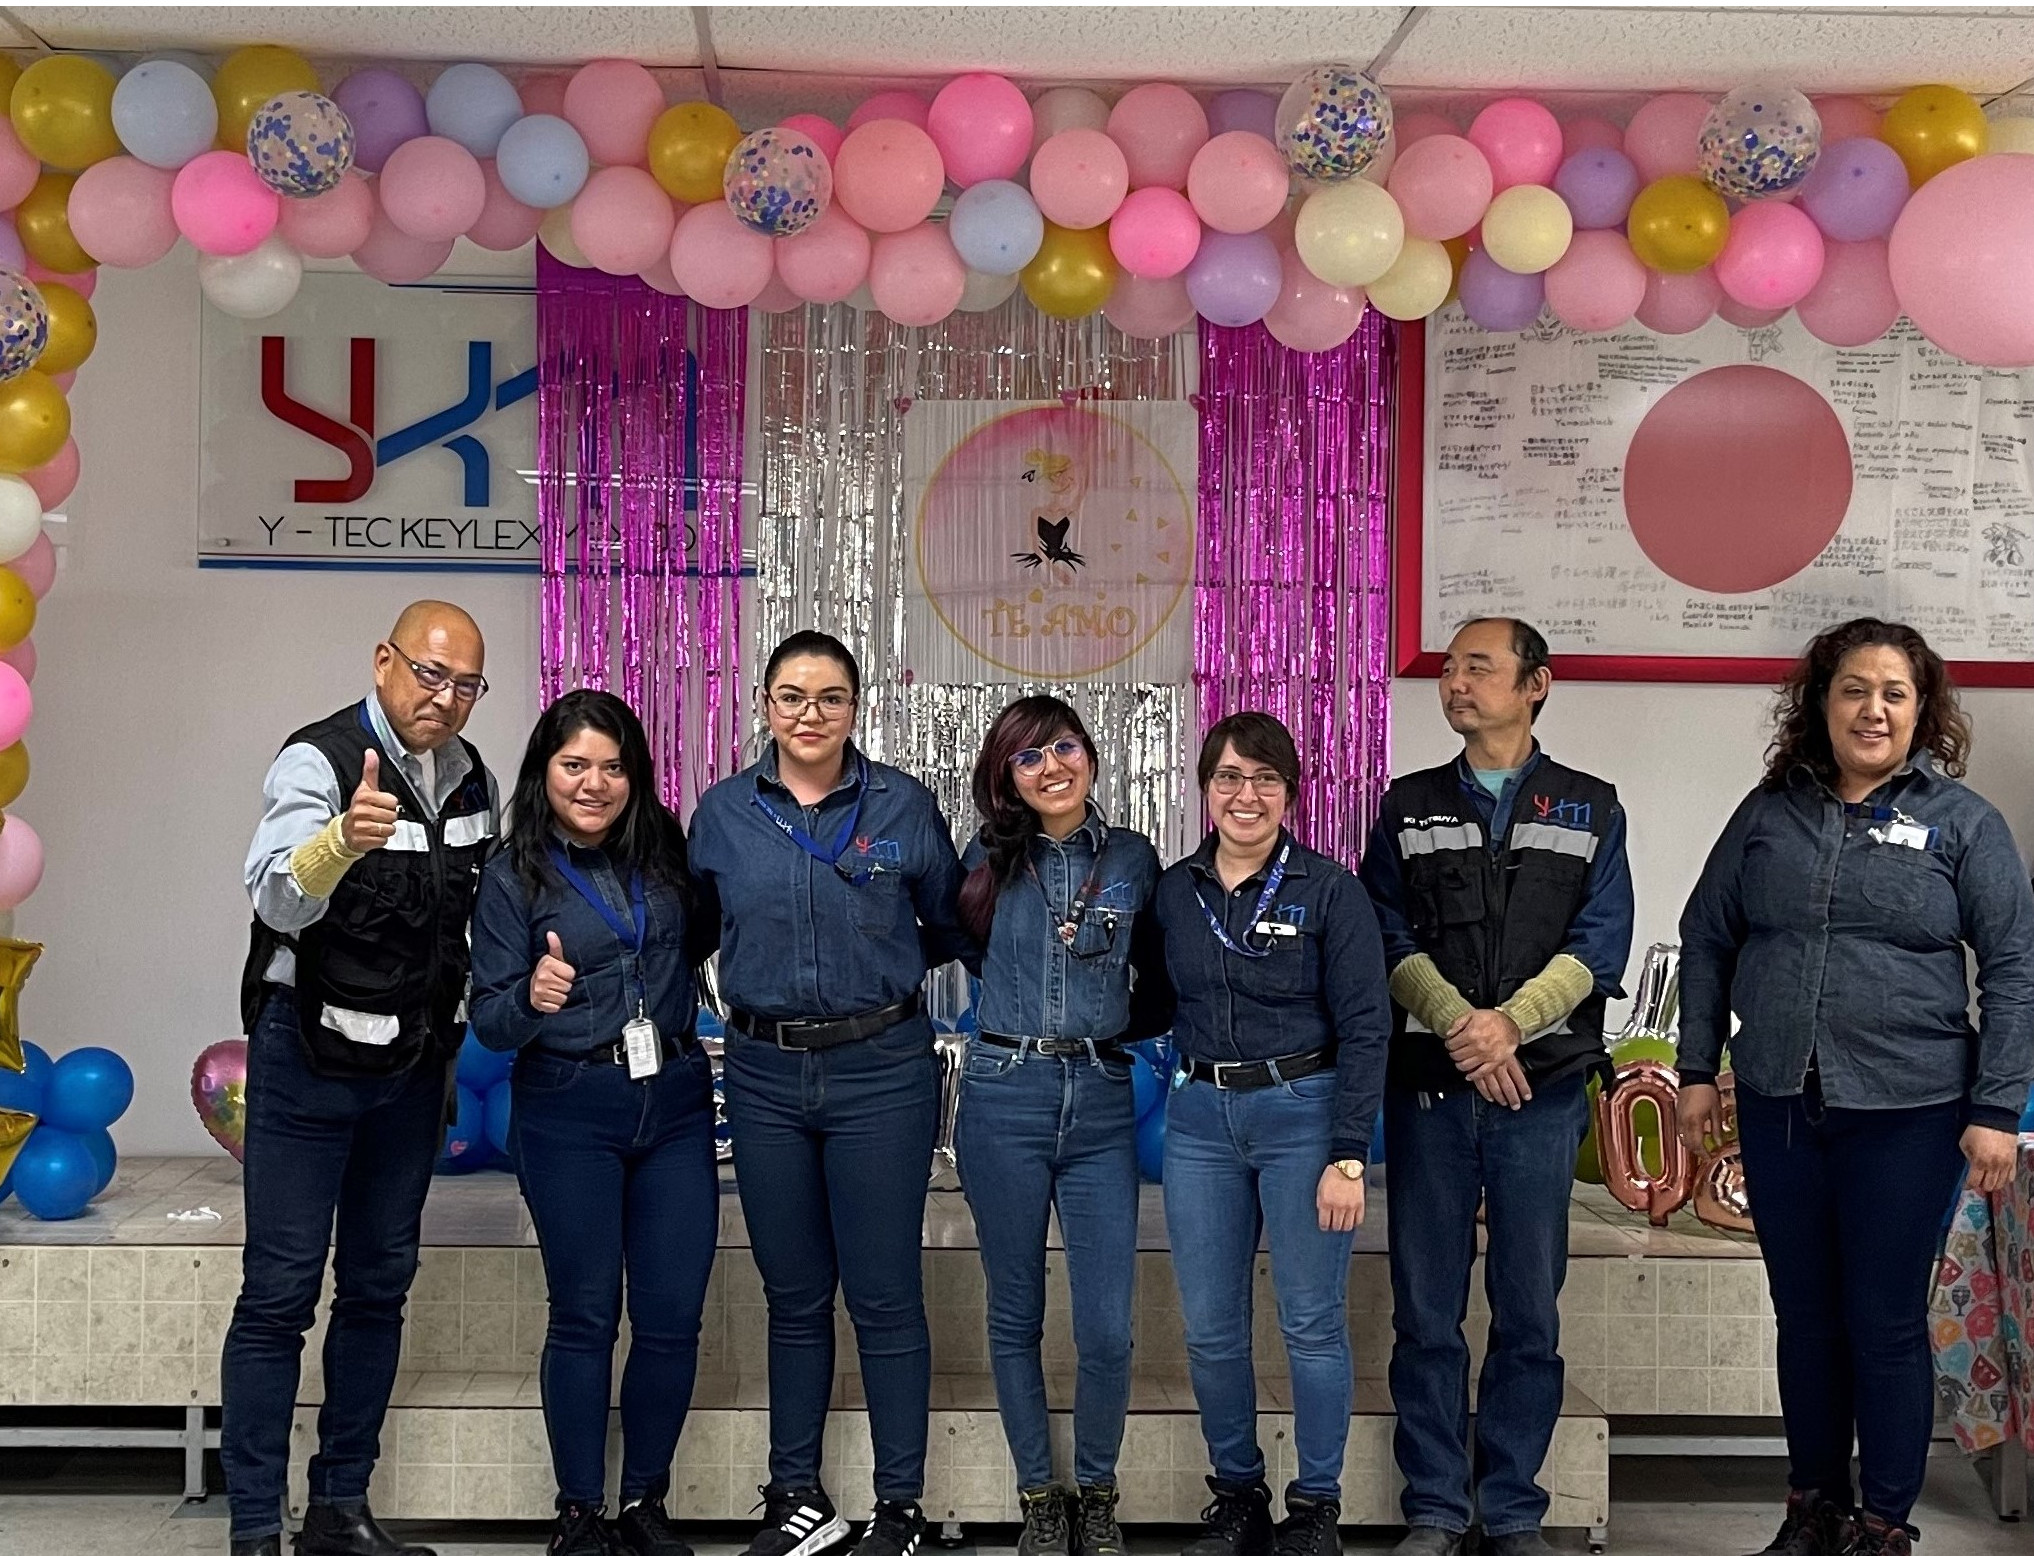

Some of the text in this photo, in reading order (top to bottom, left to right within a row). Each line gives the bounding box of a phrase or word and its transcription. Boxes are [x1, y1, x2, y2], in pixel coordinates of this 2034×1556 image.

[259, 516, 284, 545] Y
[324, 517, 391, 547] TEC
[401, 518, 541, 550] KEYLEX
